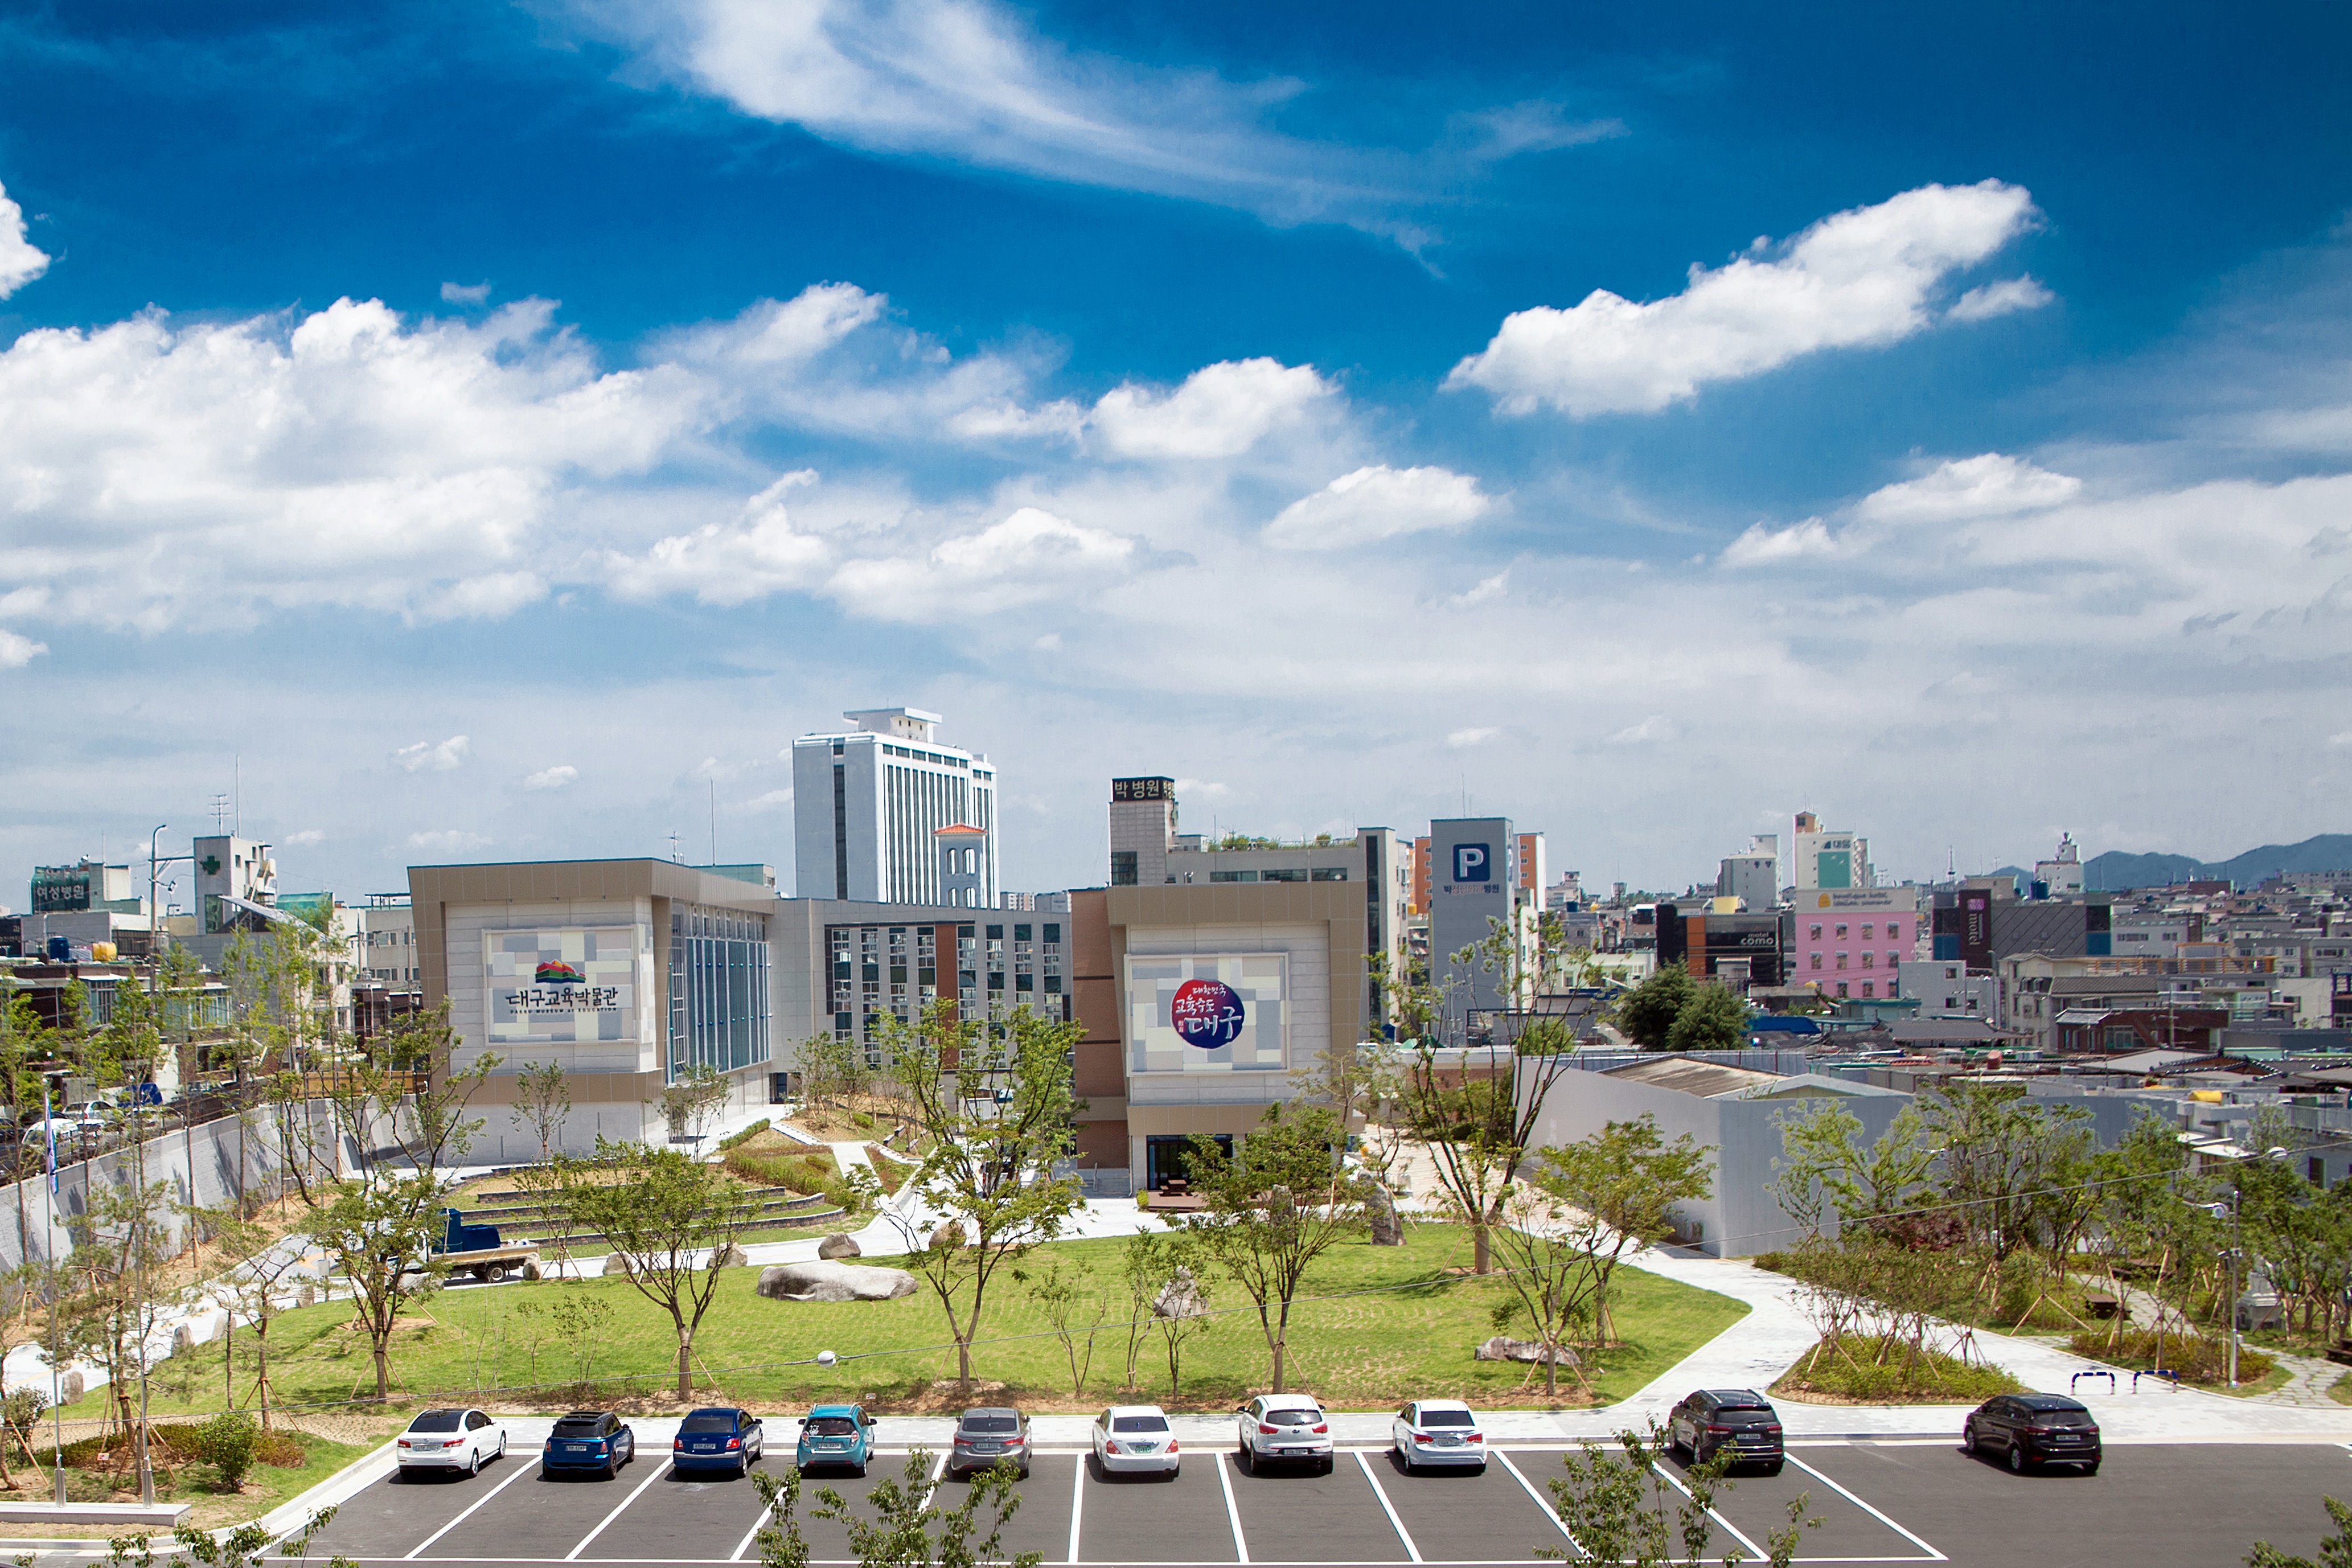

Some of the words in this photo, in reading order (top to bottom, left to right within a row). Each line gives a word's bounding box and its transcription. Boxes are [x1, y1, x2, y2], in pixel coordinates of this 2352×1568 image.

[1115, 781, 1128, 798] 박
[1132, 779, 1159, 798] 병원
[1459, 848, 1484, 877] P
[37, 885, 84, 900] 여성병원
[1968, 913, 1981, 945] motel
[506, 987, 618, 1007] 대구교육박물관
[1192, 984, 1226, 997] 대한민국
[1176, 994, 1214, 1016] 교육수도
[1184, 1006, 1242, 1039] 대구
